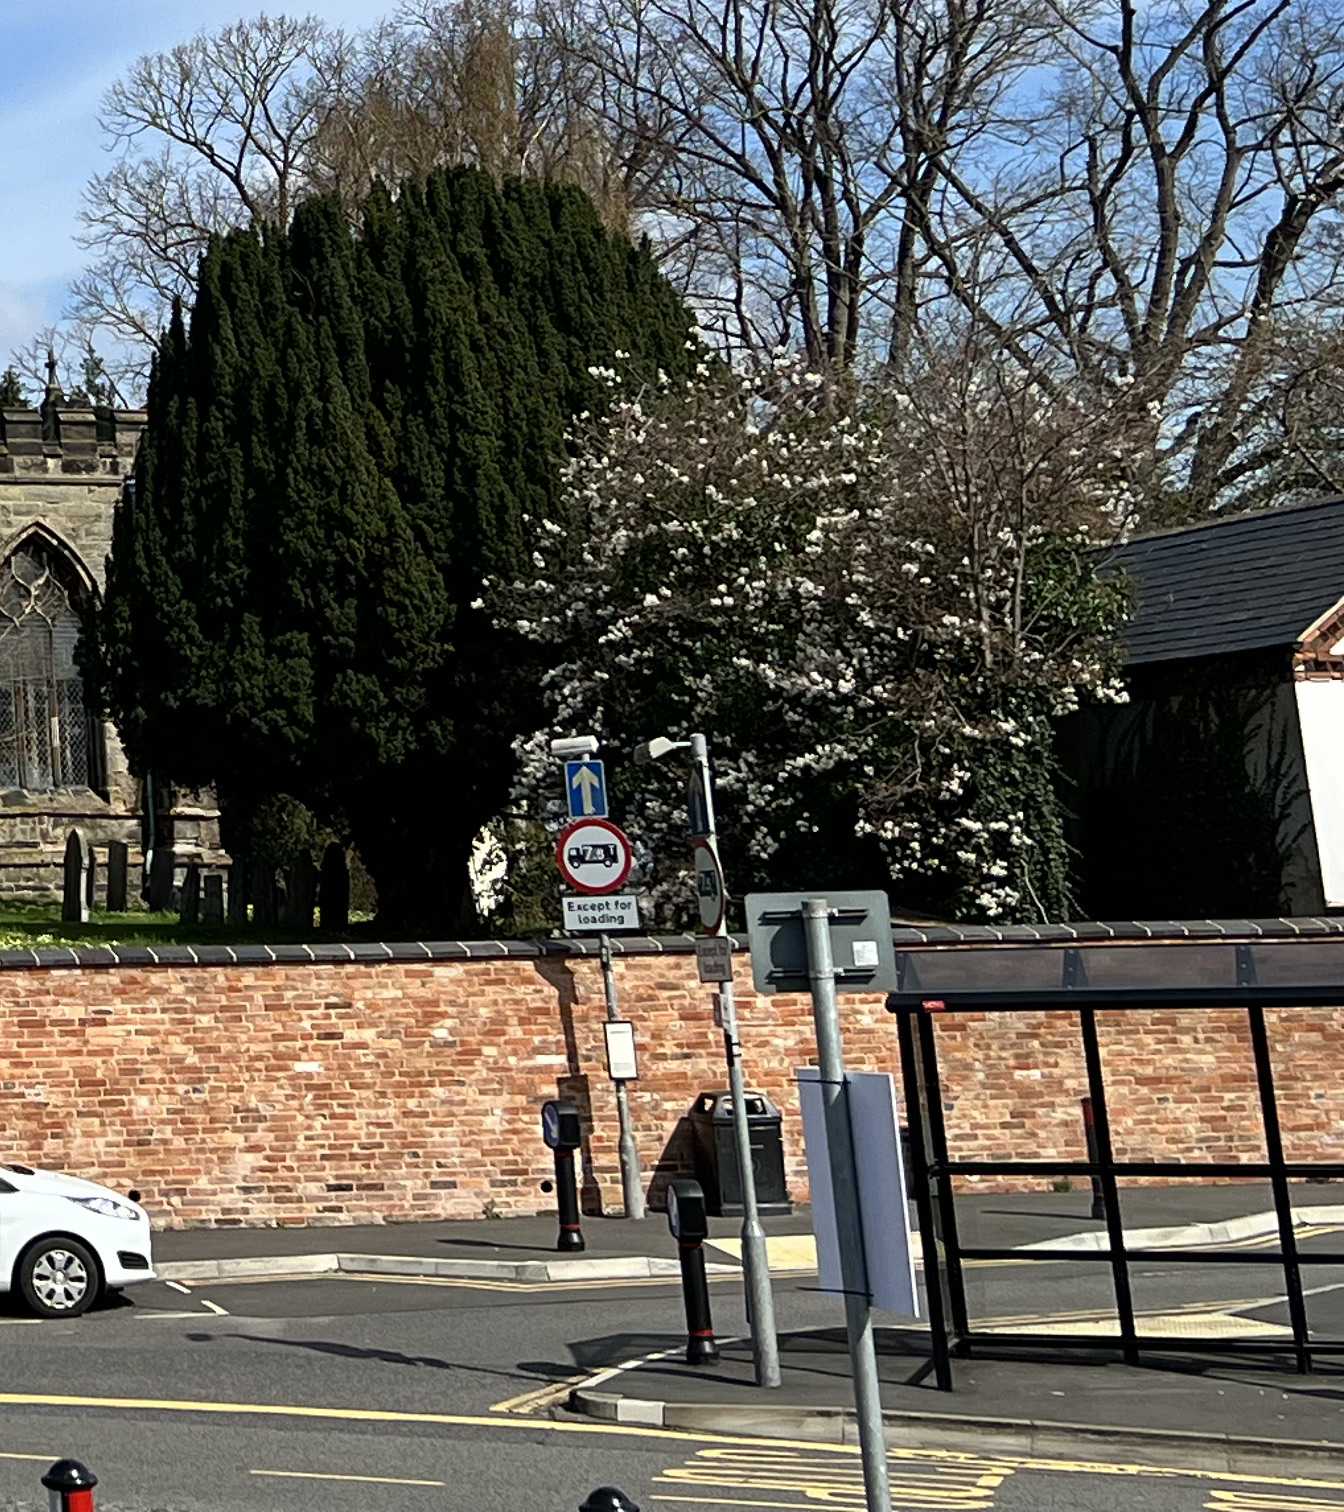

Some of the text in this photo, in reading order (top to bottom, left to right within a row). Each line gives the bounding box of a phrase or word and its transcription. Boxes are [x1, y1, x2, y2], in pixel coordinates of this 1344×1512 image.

[568, 899, 632, 912] Except for
[578, 913, 625, 925] loading
